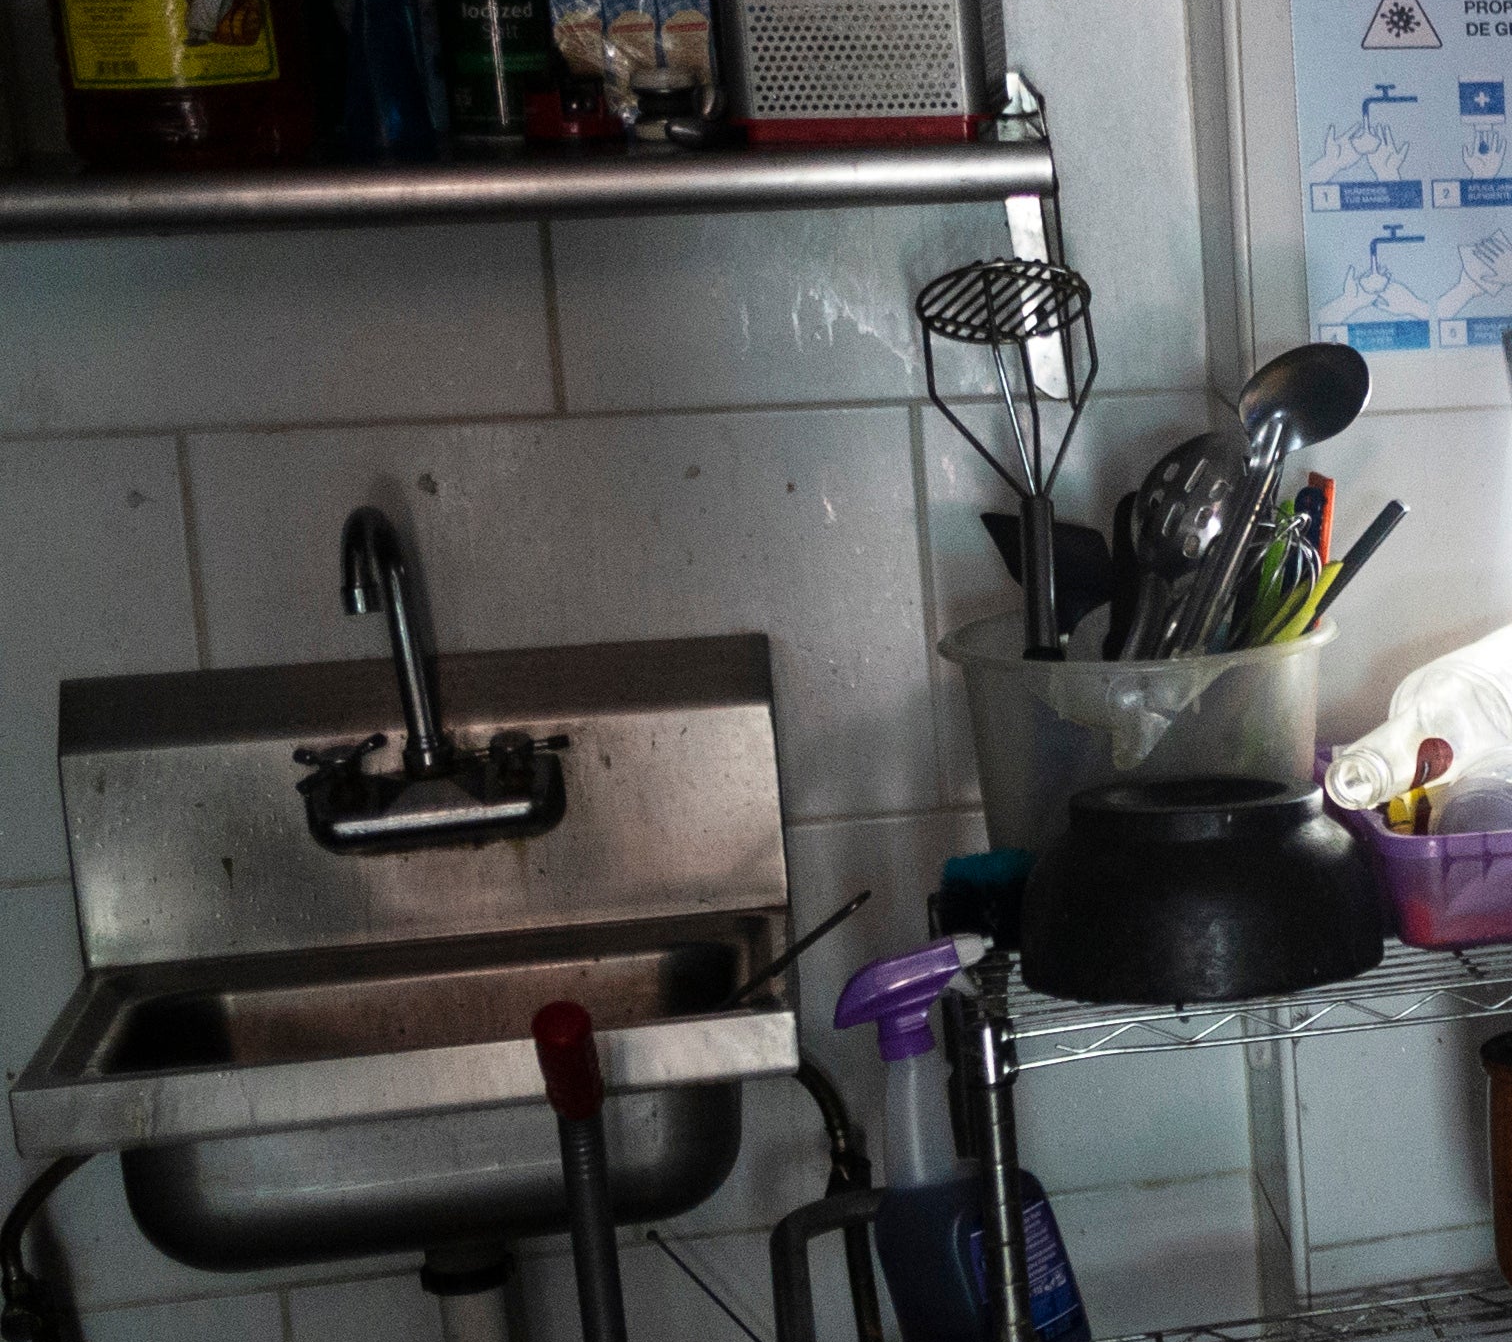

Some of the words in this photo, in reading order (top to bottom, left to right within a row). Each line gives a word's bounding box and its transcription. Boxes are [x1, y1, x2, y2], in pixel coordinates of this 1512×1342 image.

[461, 1, 534, 19] Iozed
[481, 21, 519, 40] Slt
[1465, 20, 1491, 38] DE
